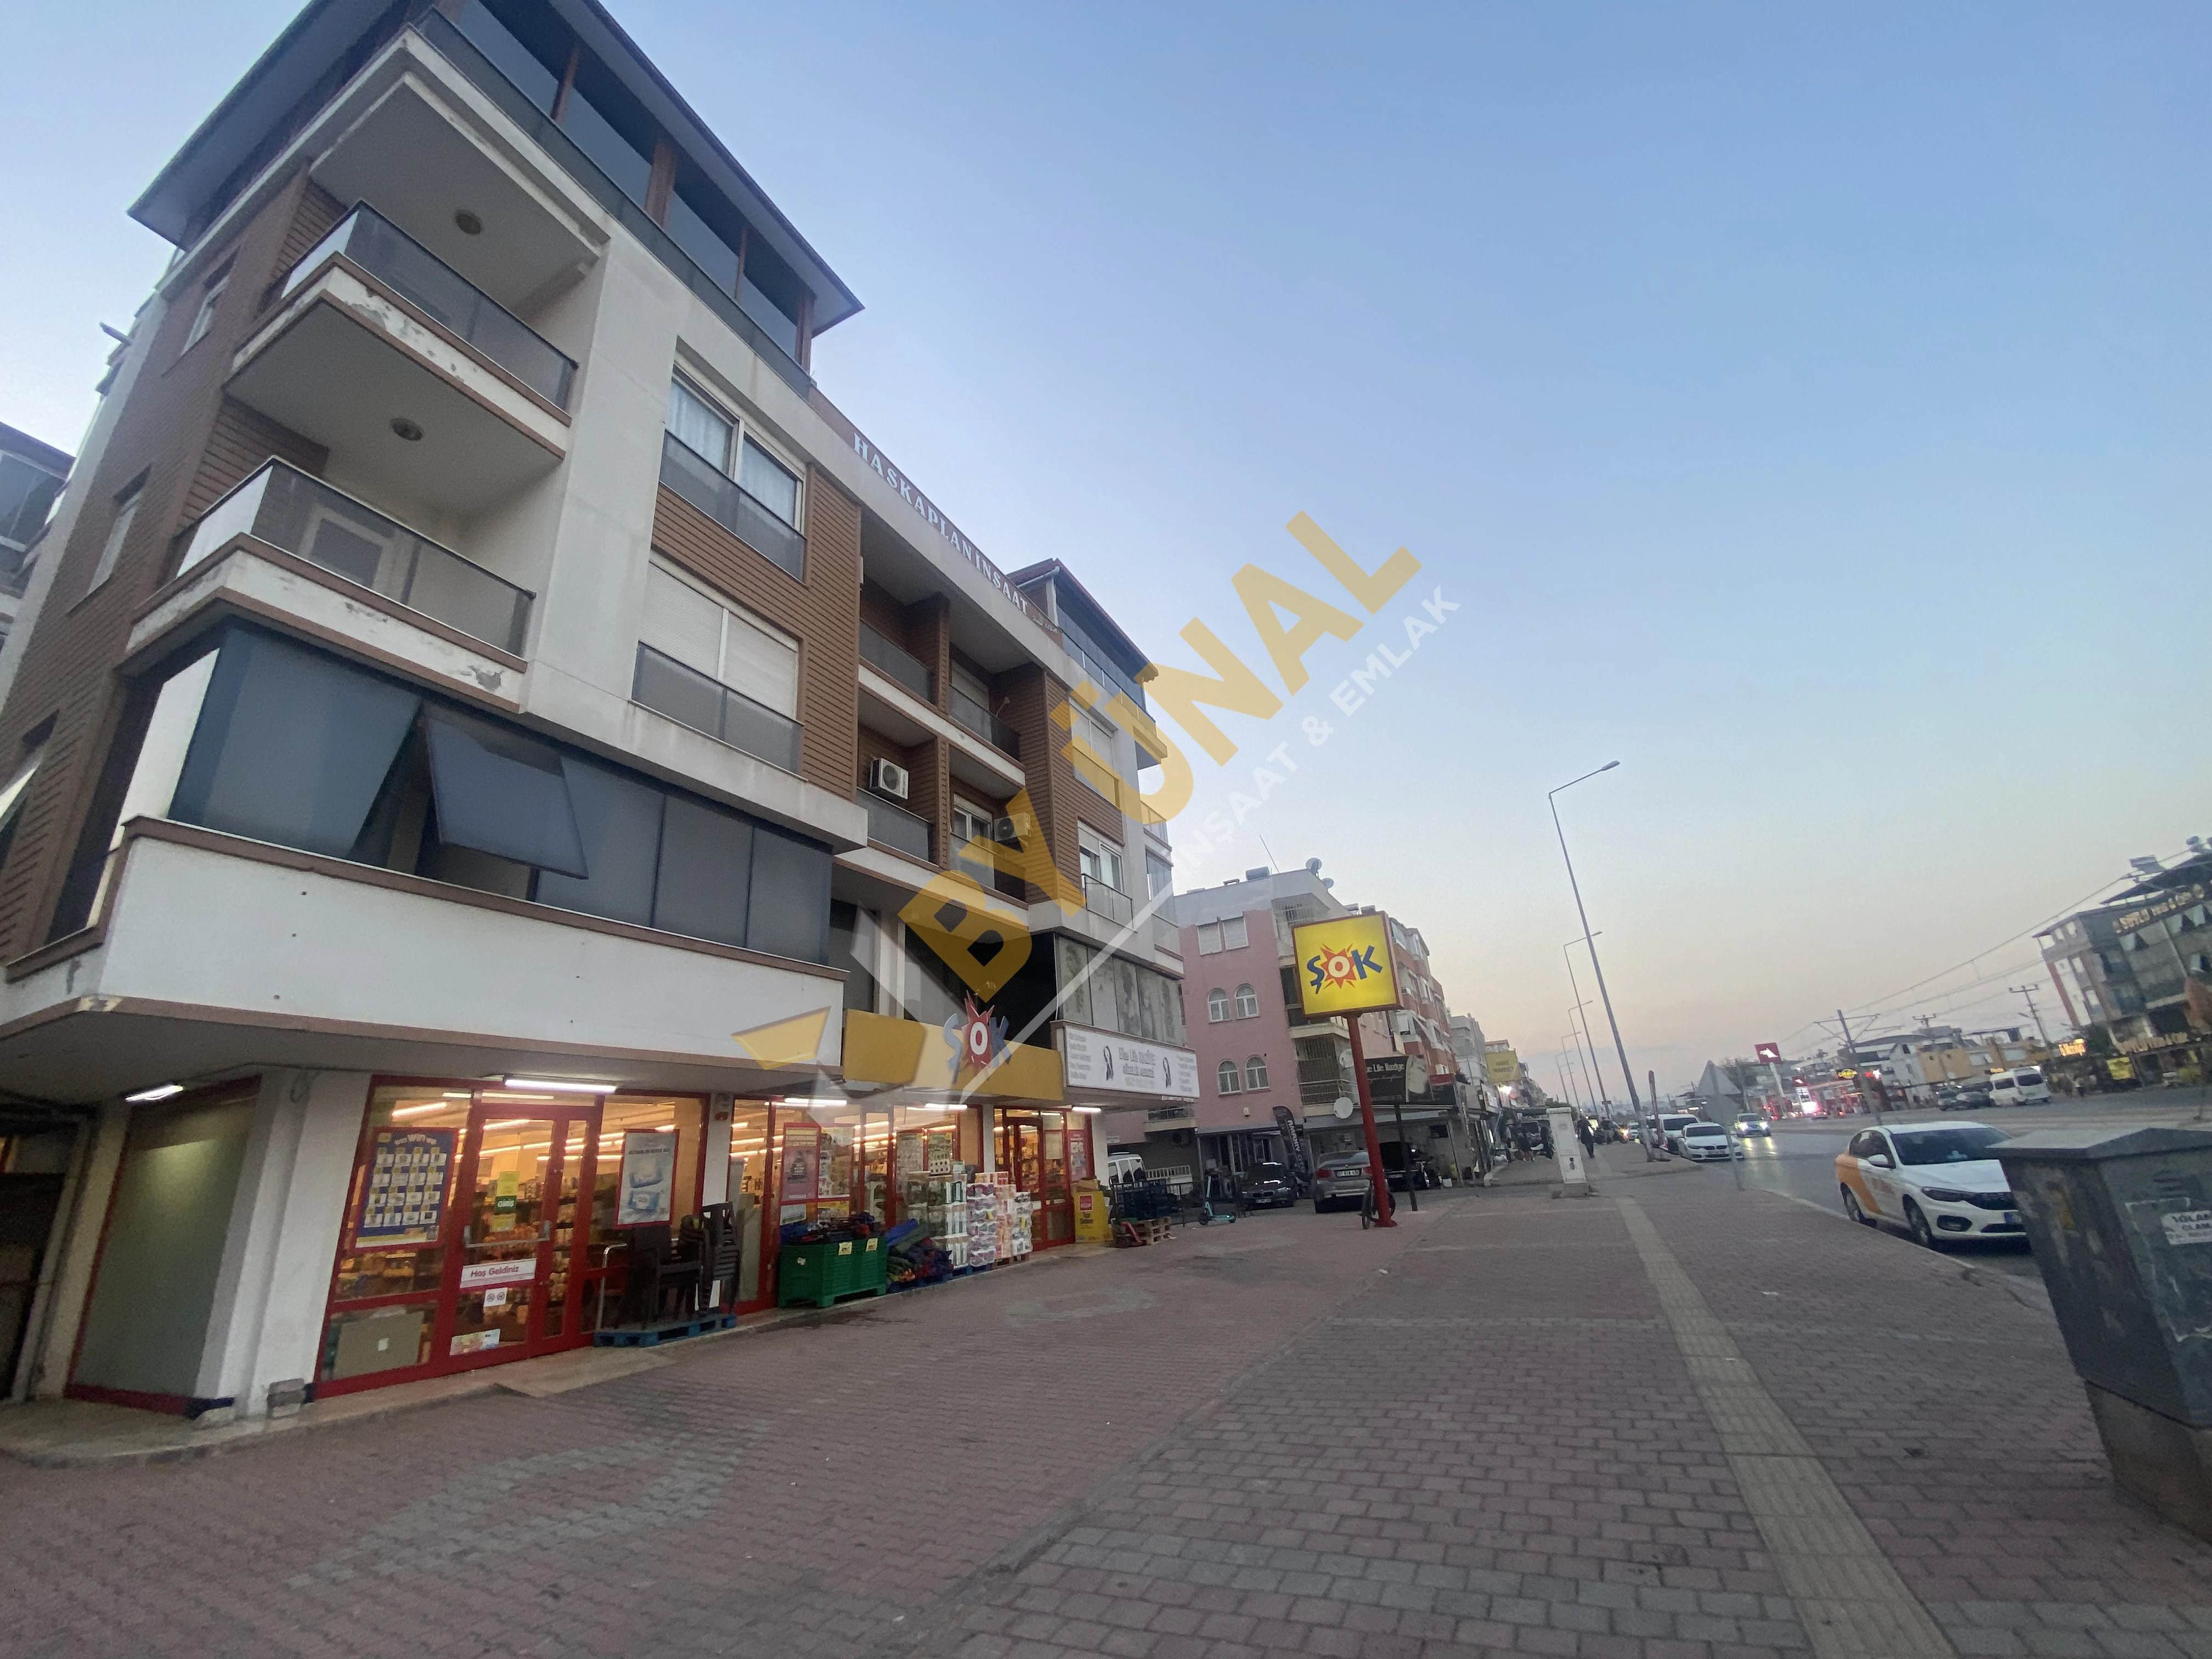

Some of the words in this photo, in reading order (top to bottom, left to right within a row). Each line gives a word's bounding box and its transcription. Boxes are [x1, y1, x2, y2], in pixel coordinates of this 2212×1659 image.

[1307, 945, 1383, 995] ŞOK
[470, 1269, 487, 1278] Hoş
[488, 1265, 520, 1275] Geldiniz
